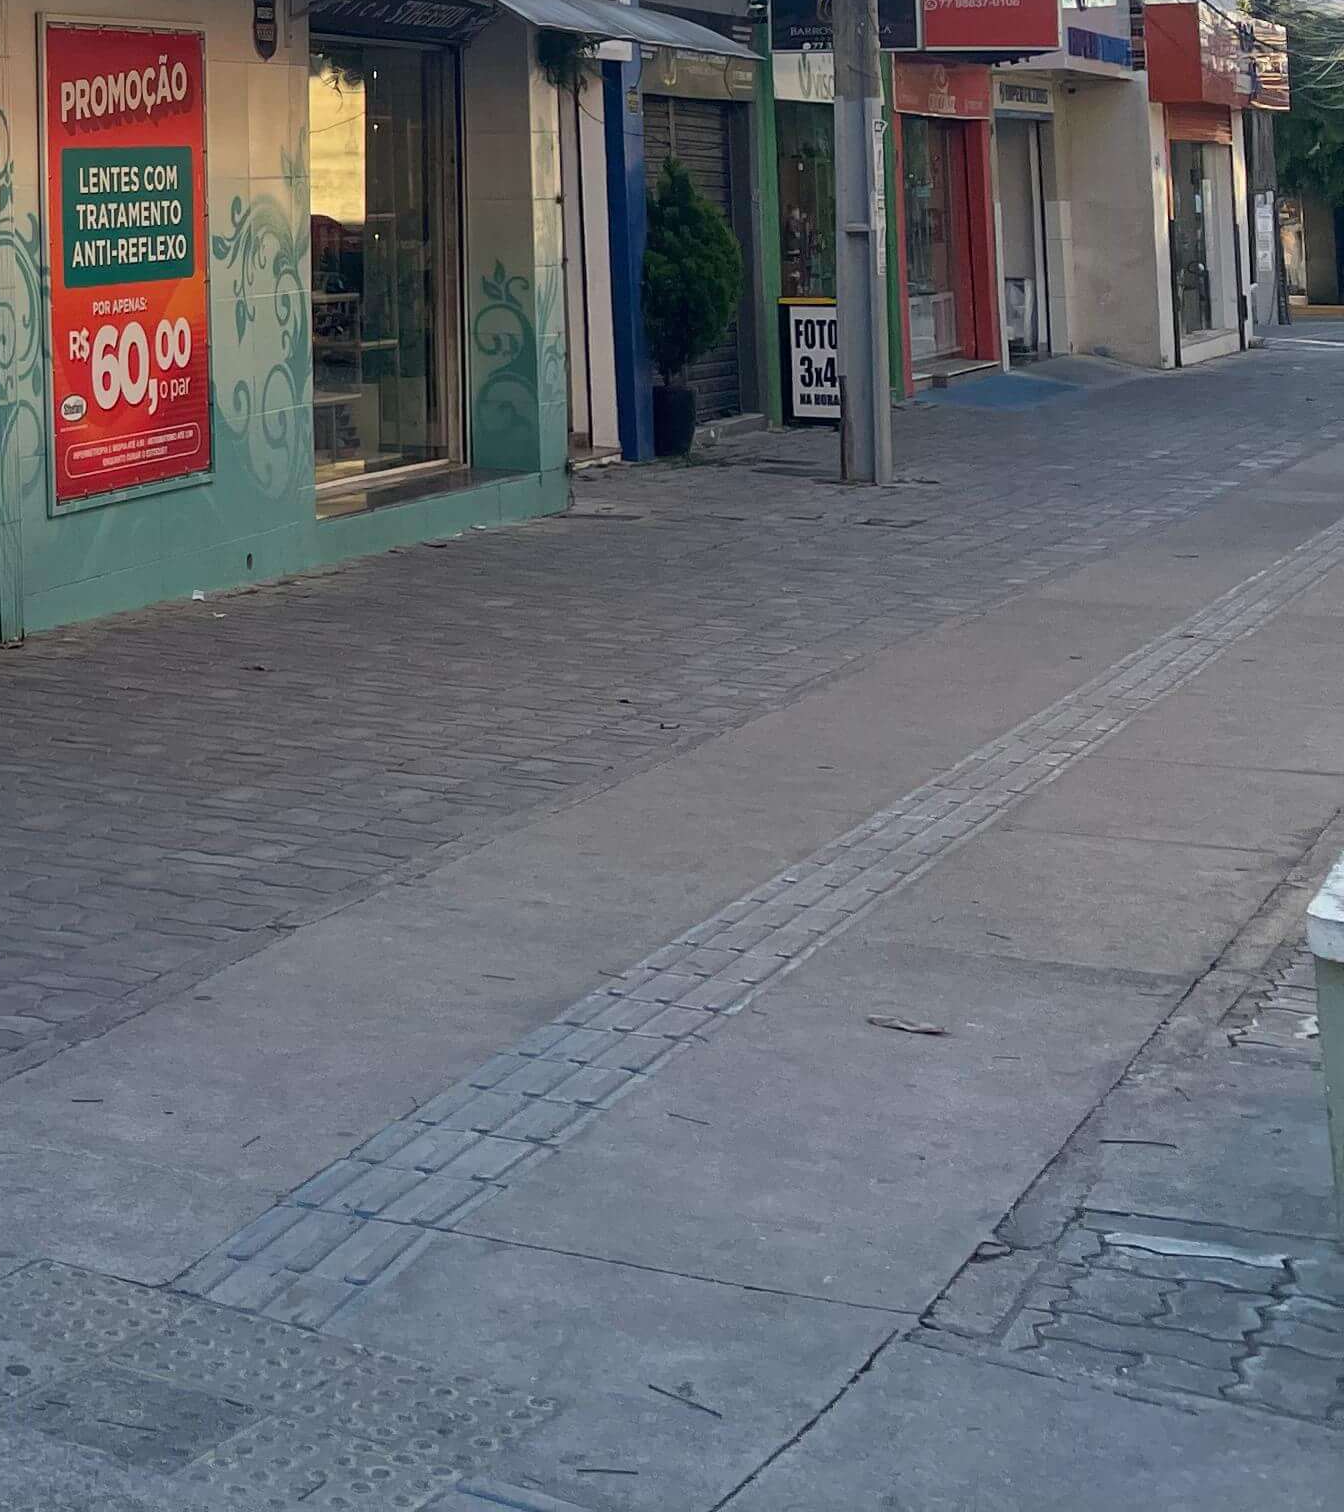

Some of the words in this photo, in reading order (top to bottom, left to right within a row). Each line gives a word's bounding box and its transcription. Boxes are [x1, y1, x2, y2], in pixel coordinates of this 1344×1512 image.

[60, 55, 188, 124] PROMOÇÃO
[79, 166, 140, 195] LENTES
[143, 163, 178, 191] COM
[76, 199, 182, 231] TRATAMENTO
[72, 235, 187, 269] ANTI-REFLEXO
[92, 299, 111, 316] POR
[112, 296, 148, 315] APENAS:
[68, 328, 91, 362] R$
[794, 318, 838, 349] FOTO
[159, 381, 168, 399] o
[171, 373, 191, 402] par
[799, 355, 838, 388] 3x4
